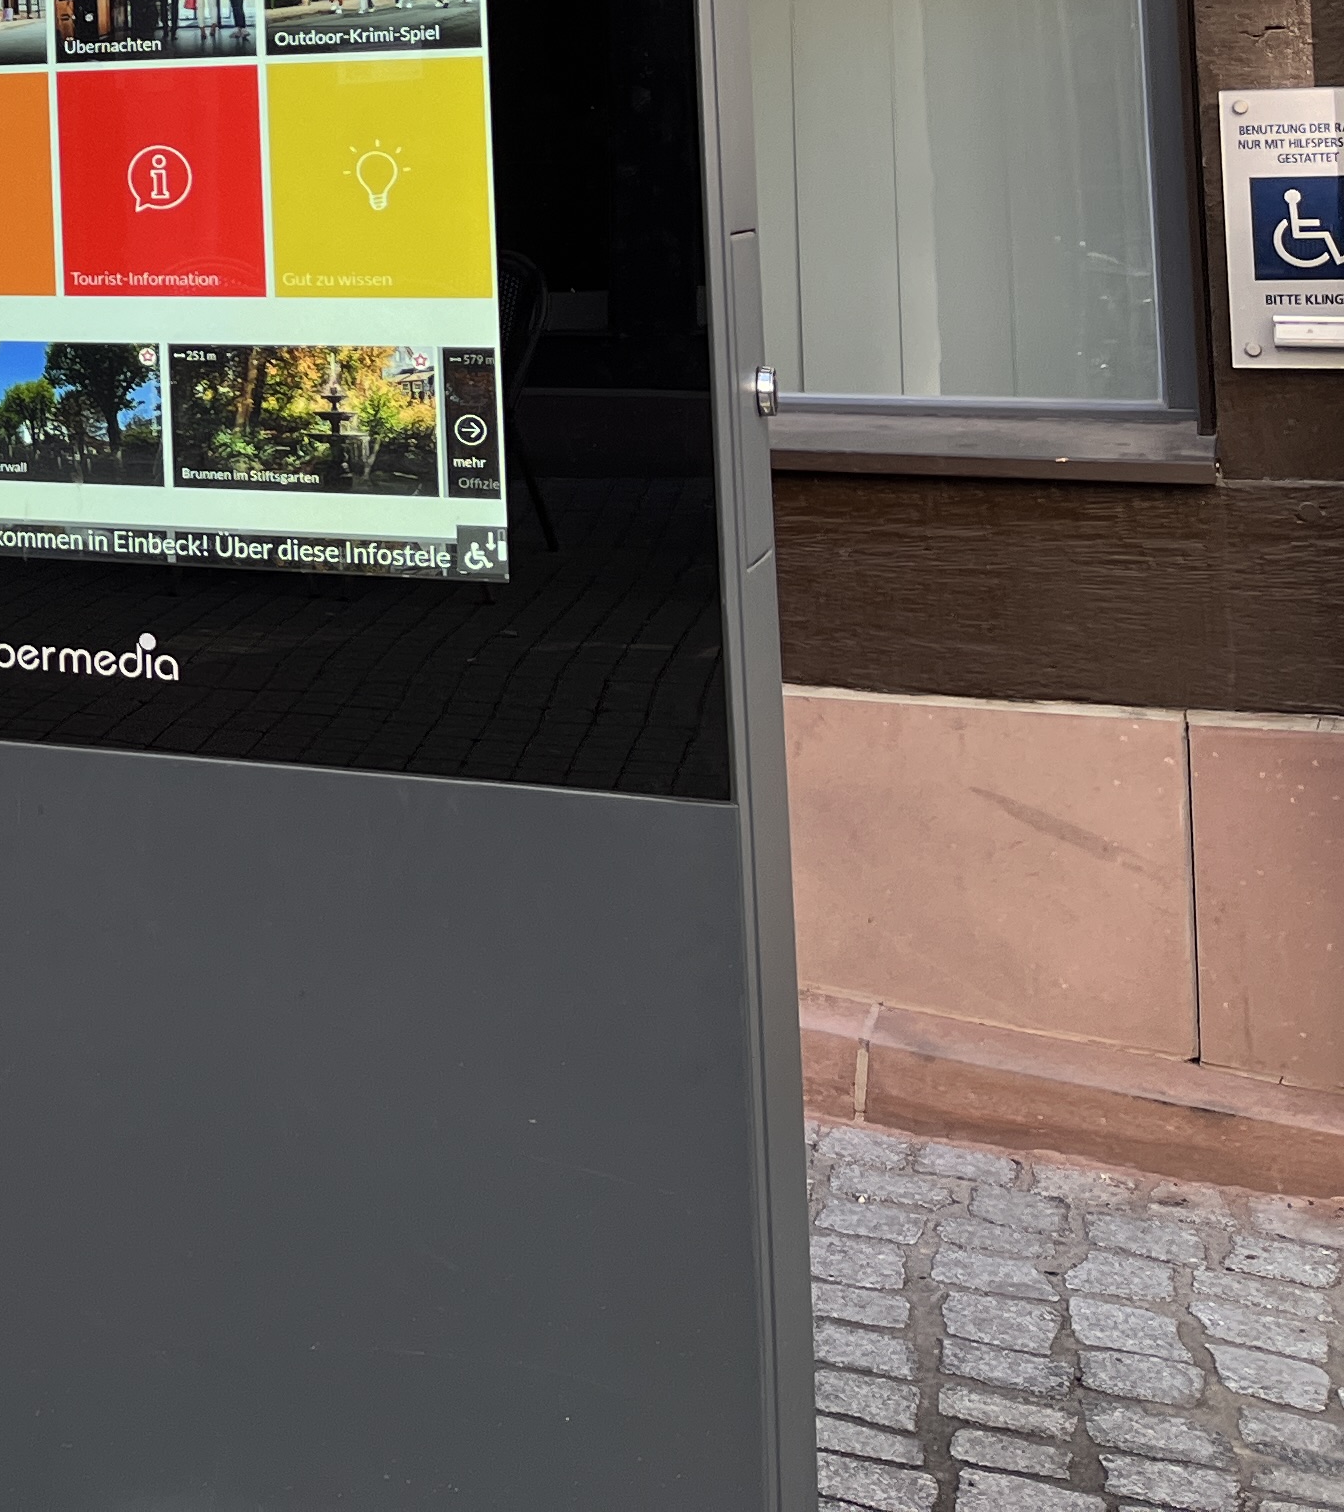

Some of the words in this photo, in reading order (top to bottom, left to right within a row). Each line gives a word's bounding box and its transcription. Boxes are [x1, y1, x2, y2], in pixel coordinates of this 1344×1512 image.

[274, 24, 441, 48] Outdoor-Krimi-Spiel
[63, 36, 162, 55] Übernachten
[1238, 123, 1307, 136] BENUTZUNG
[1309, 122, 1331, 134] DER
[1334, 122, 1344, 133] R
[1237, 139, 1262, 150] NUR
[1264, 138, 1286, 149] MIT
[1277, 151, 1340, 164] GESTATTET
[70, 270, 220, 288] Tourist-Information
[281, 271, 312, 287] Gut
[315, 274, 335, 287] zu
[337, 271, 393, 287] wissen
[1265, 293, 1302, 306] BITTE
[185, 350, 205, 362] 251
[206, 352, 217, 362] m
[463, 354, 484, 366] 579
[453, 456, 487, 469] mehr
[182, 467, 232, 482] Brunnen
[233, 469, 248, 482] im
[249, 468, 320, 485] Stiftsgarten
[87, 528, 109, 552] in
[113, 530, 210, 557] Einbeck!
[214, 531, 275, 560] Über
[278, 537, 340, 564] diese
[345, 541, 452, 569] Infostele
